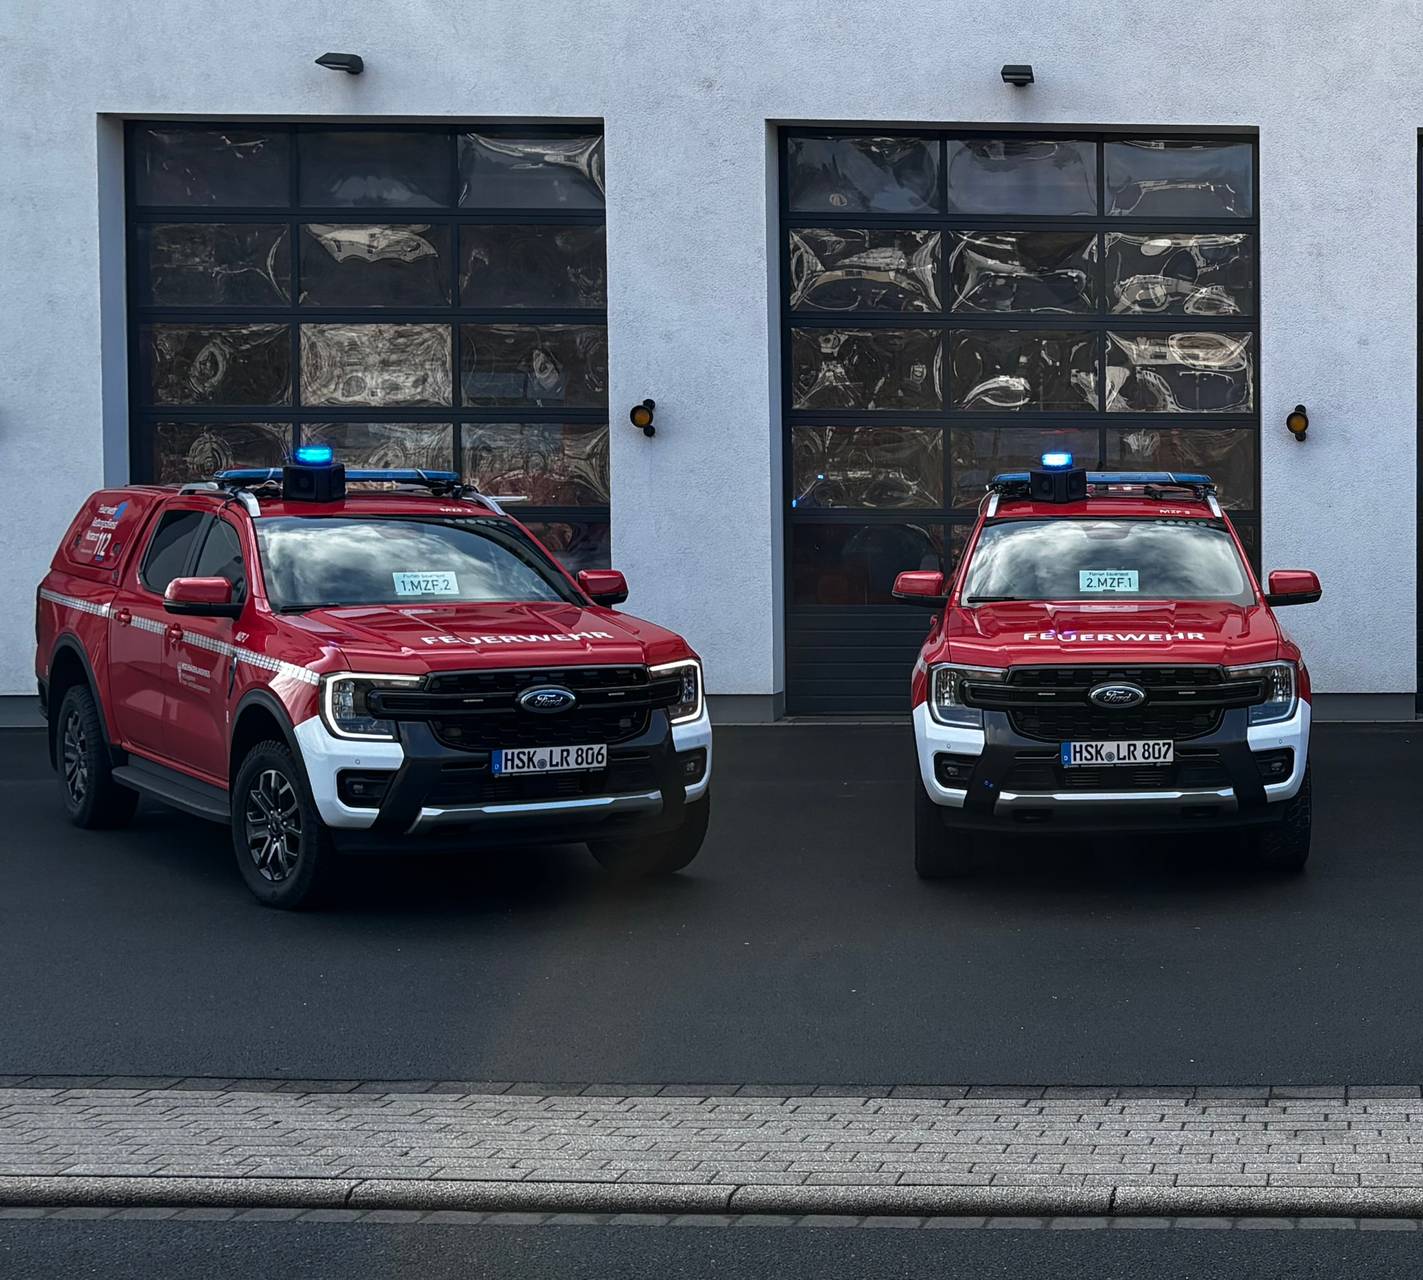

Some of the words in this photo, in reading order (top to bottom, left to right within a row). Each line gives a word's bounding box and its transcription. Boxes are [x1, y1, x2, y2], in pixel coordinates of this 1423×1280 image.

[94, 532, 112, 556] 112
[401, 579, 451, 592] 1.MZF.2
[1086, 577, 1132, 588] 2.MZF.1
[421, 631, 614, 645] FEUERWEHR
[1023, 631, 1205, 642] FEUERWEHR
[534, 694, 563, 707] Ford
[1104, 690, 1132, 703] Ford
[504, 750, 537, 770] HSK
[549, 748, 571, 767] LR
[575, 746, 605, 766] 806
[1073, 743, 1104, 761] HSK
[1116, 743, 1137, 761] LR
[1142, 742, 1172, 760] 807
